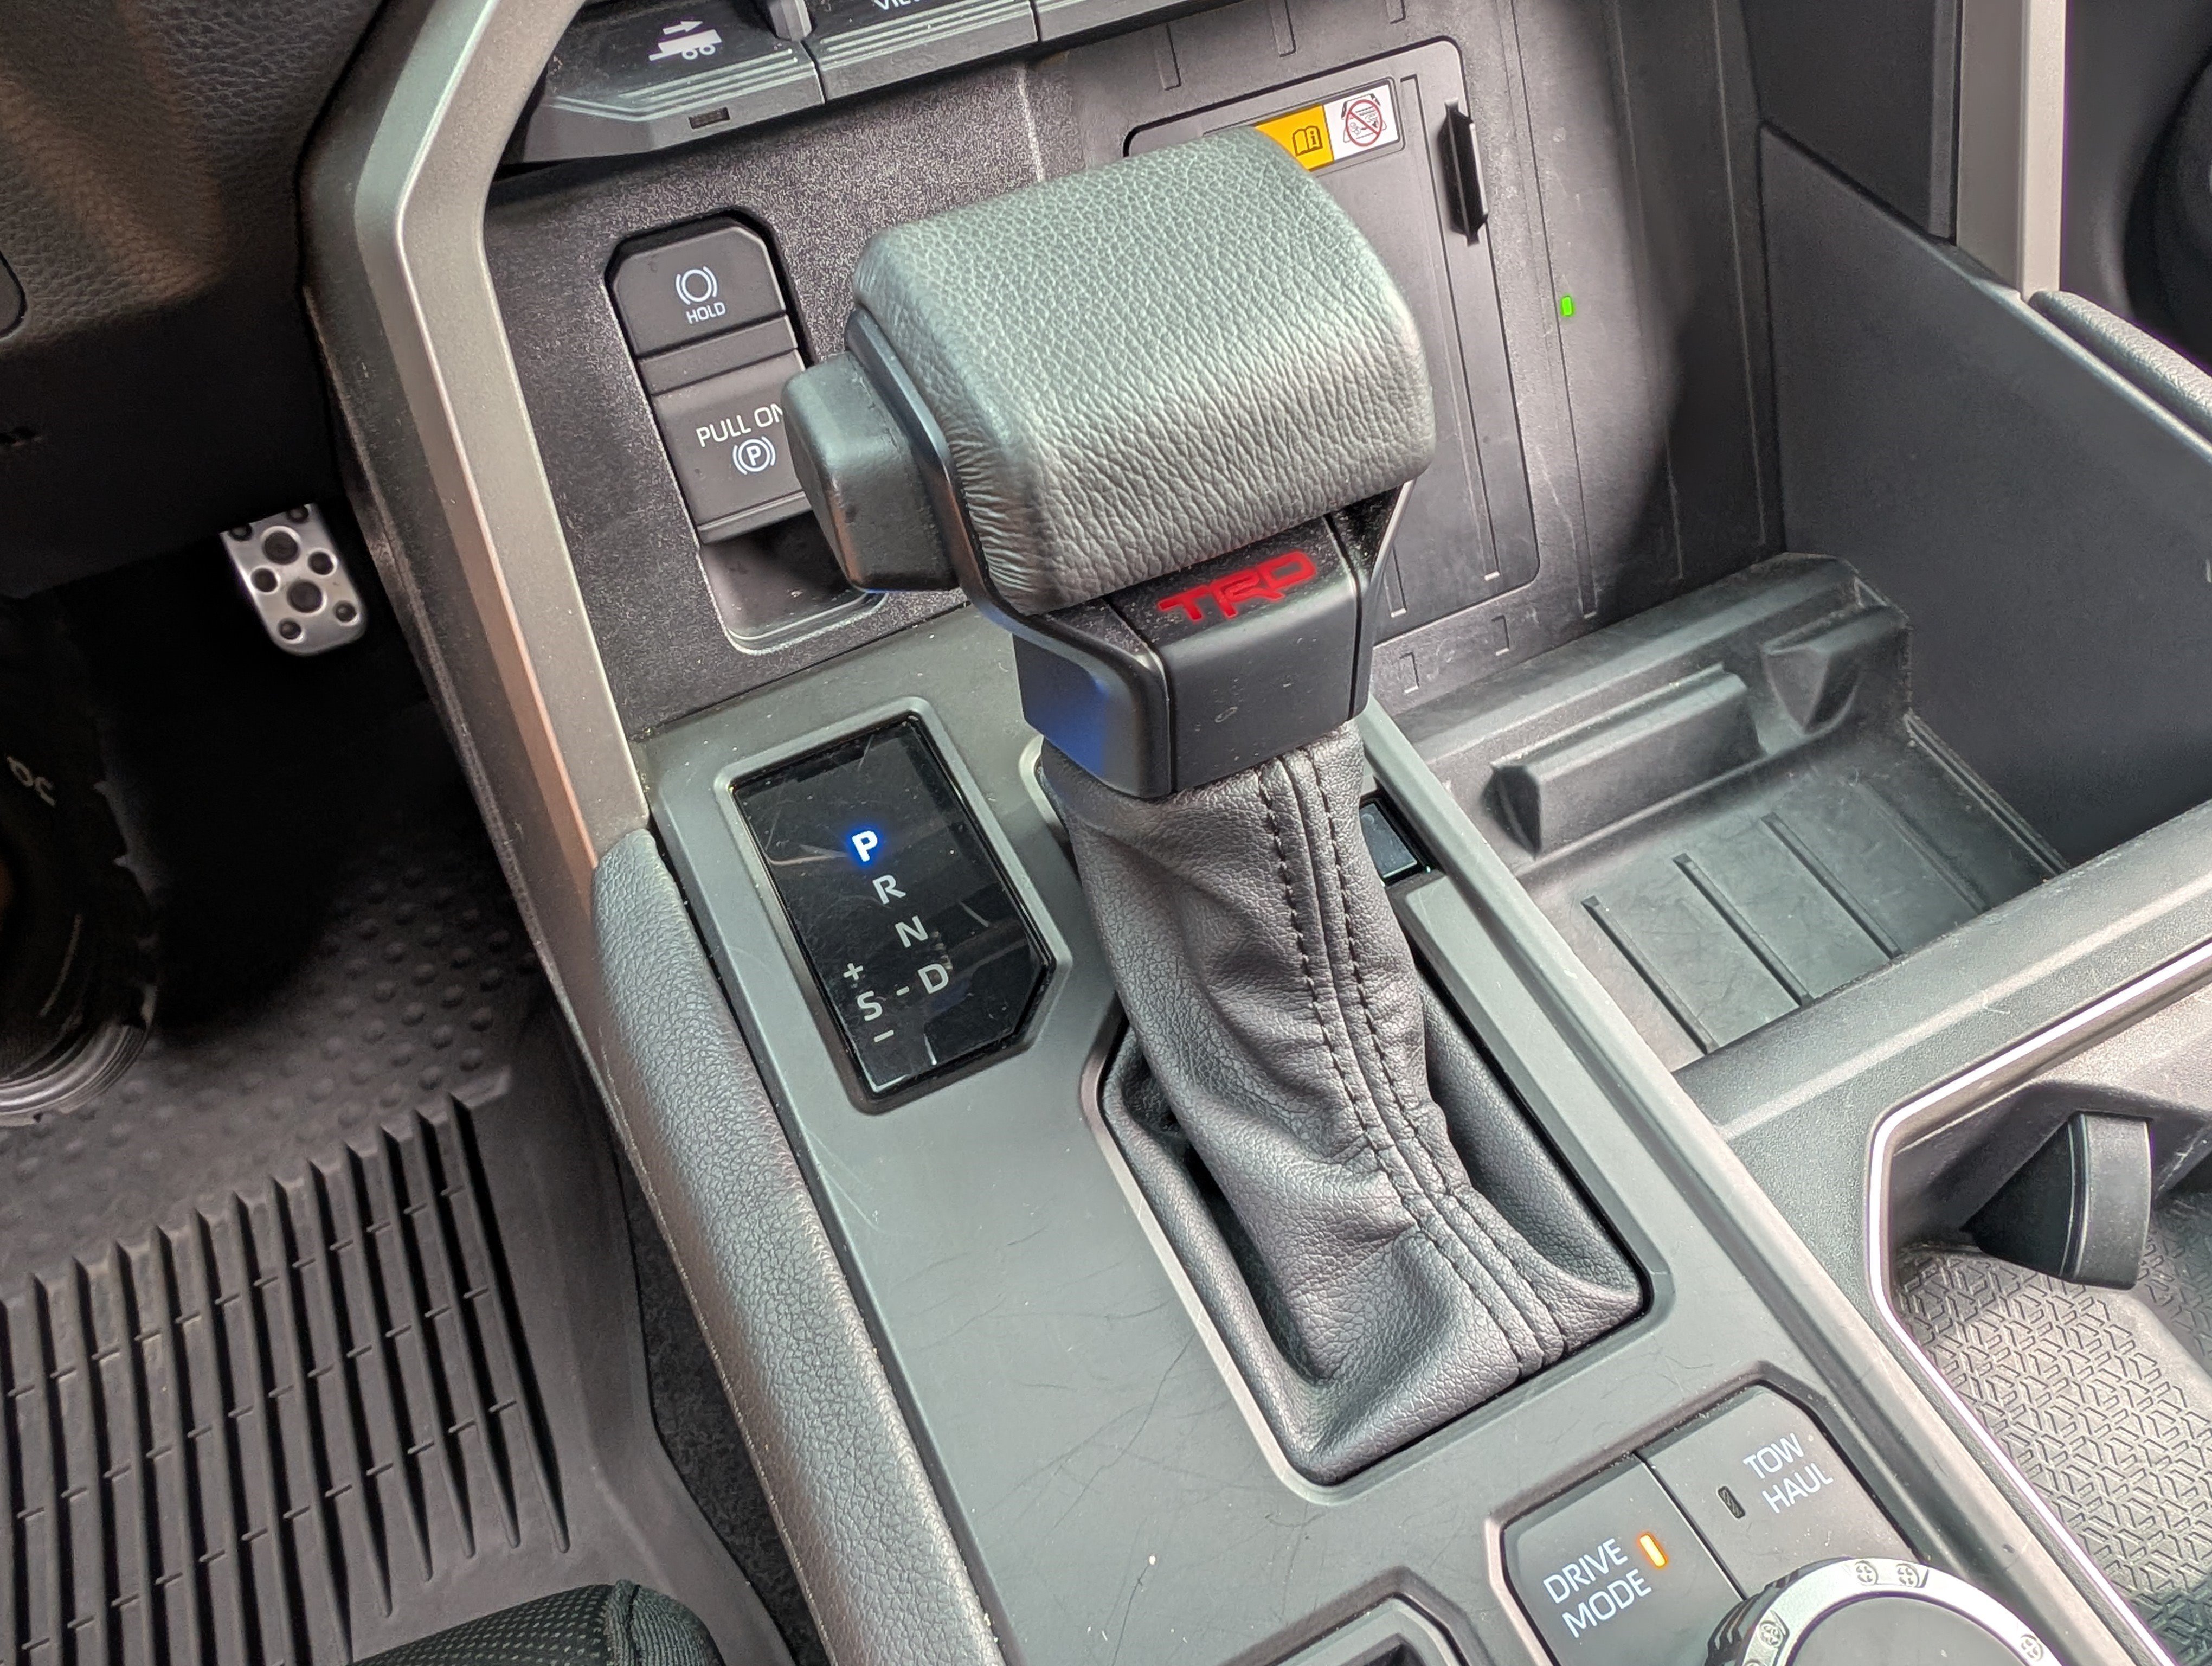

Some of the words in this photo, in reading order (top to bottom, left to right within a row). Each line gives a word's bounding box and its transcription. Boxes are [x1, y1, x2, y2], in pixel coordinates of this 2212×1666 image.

[685, 302, 726, 324] HOLD
[696, 414, 752, 448] PULL
[745, 445, 762, 467] P
[1156, 550, 1317, 621] TRD
[851, 830, 878, 863] P
[872, 874, 907, 905] R
[895, 915, 929, 948] N
[856, 990, 883, 1021] S
[917, 963, 949, 995] D
[1742, 1432, 1804, 1479] TOW
[1761, 1462, 1834, 1514] HAUL
[1542, 1537, 1628, 1604] DRIVE
[1561, 1568, 1652, 1639] MODE
